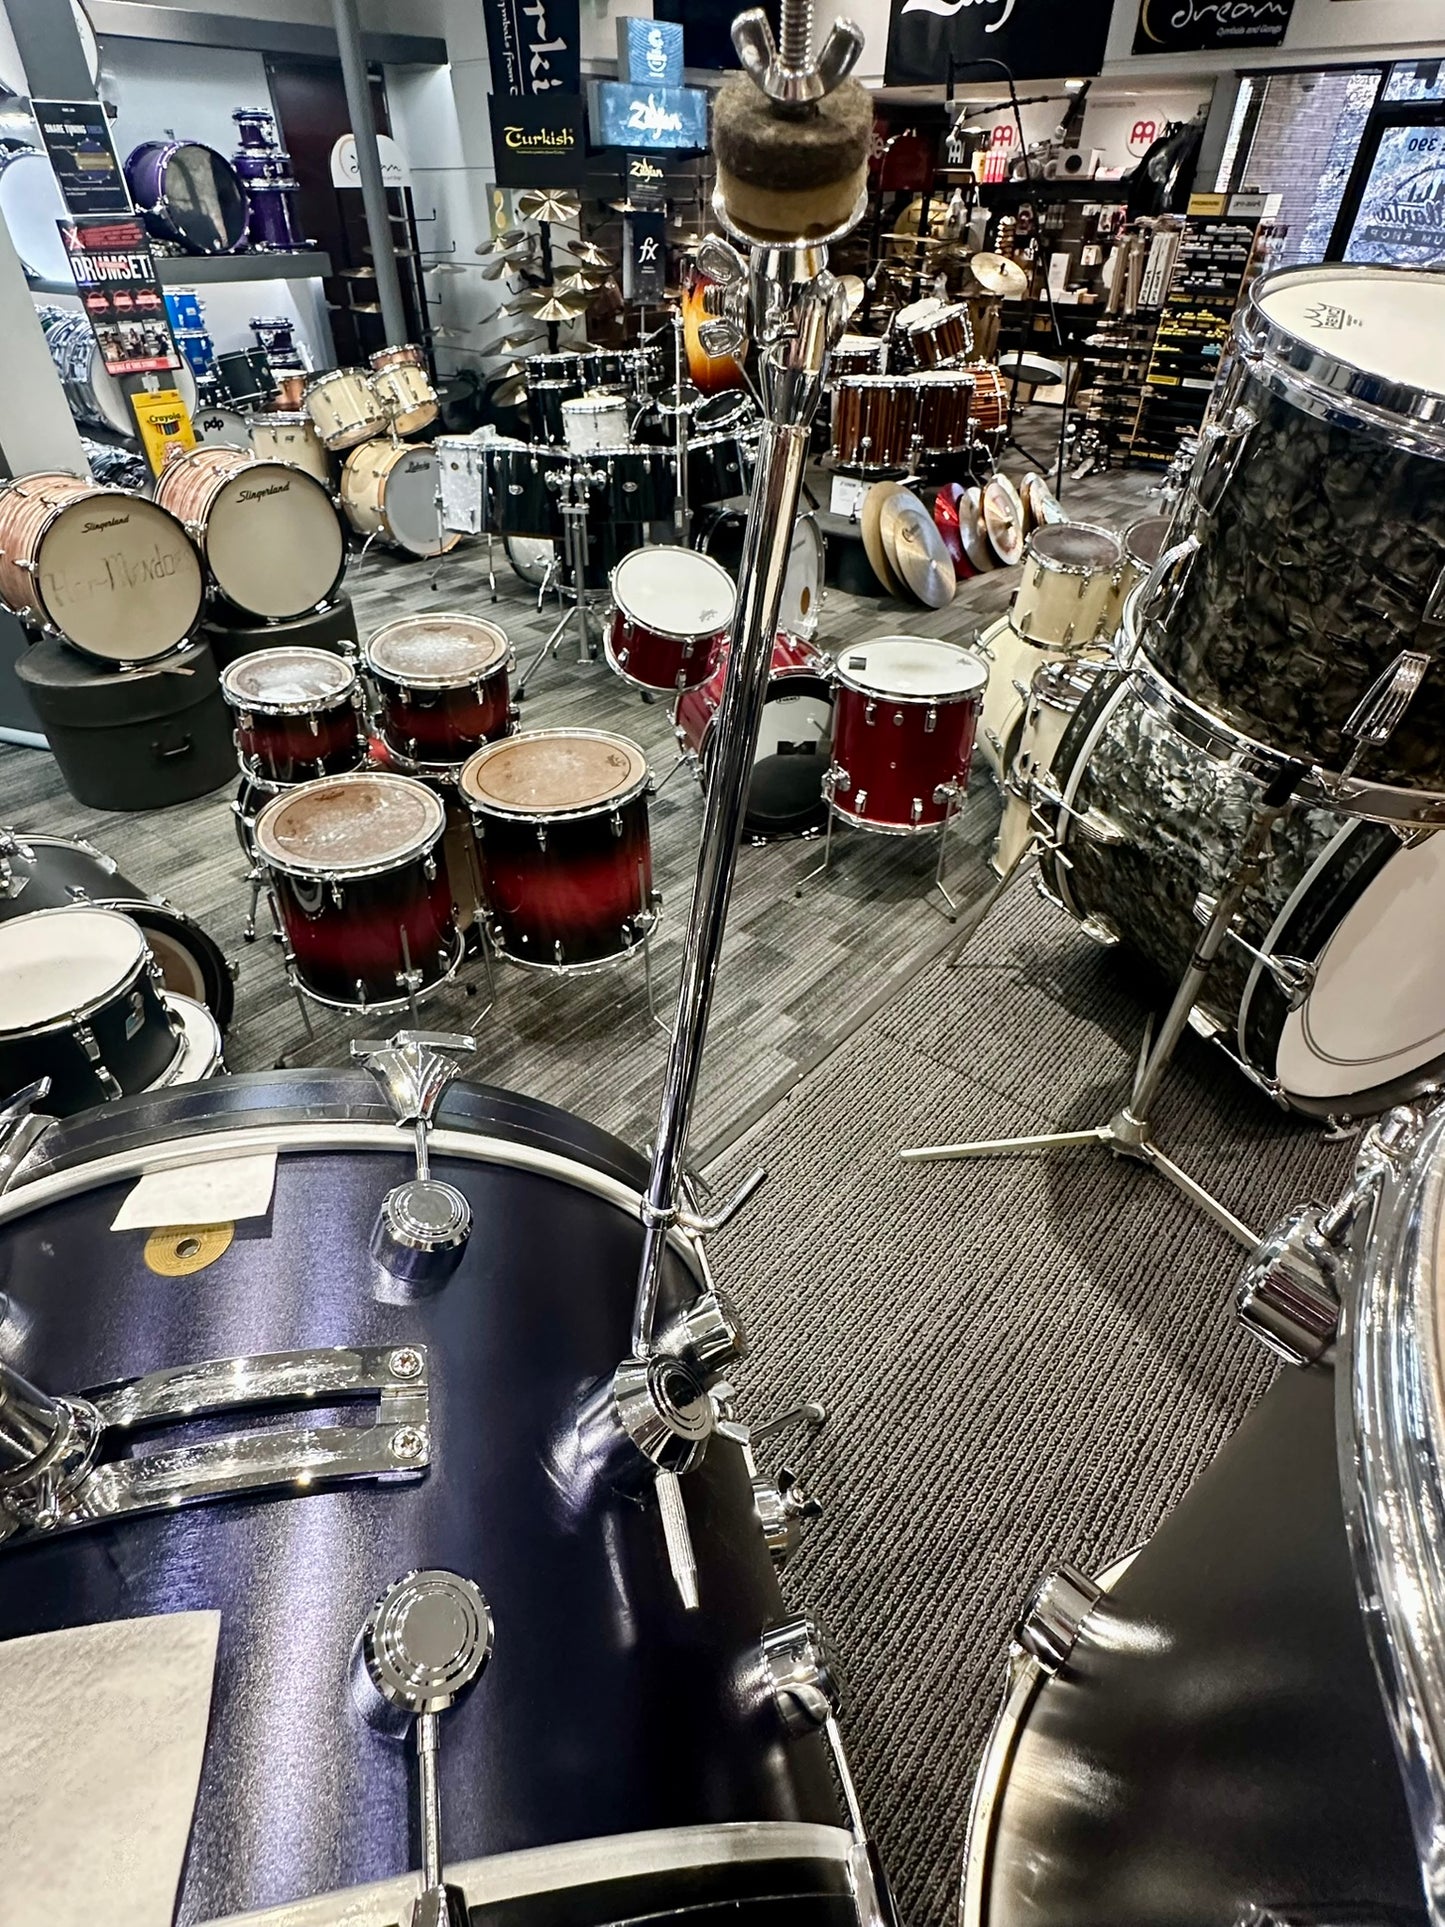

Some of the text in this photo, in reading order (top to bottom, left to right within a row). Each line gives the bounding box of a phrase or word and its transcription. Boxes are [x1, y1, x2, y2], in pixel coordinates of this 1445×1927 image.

[503, 126, 575, 148] Turkish
[629, 157, 664, 182] Zildjian
[638, 237, 659, 264] fx
[70, 254, 156, 282] DRUMSET!
[149, 412, 182, 424] Crayola
[203, 416, 224, 432] pdp
[236, 480, 290, 503] Slingerland
[81, 514, 130, 533] Slingerland
